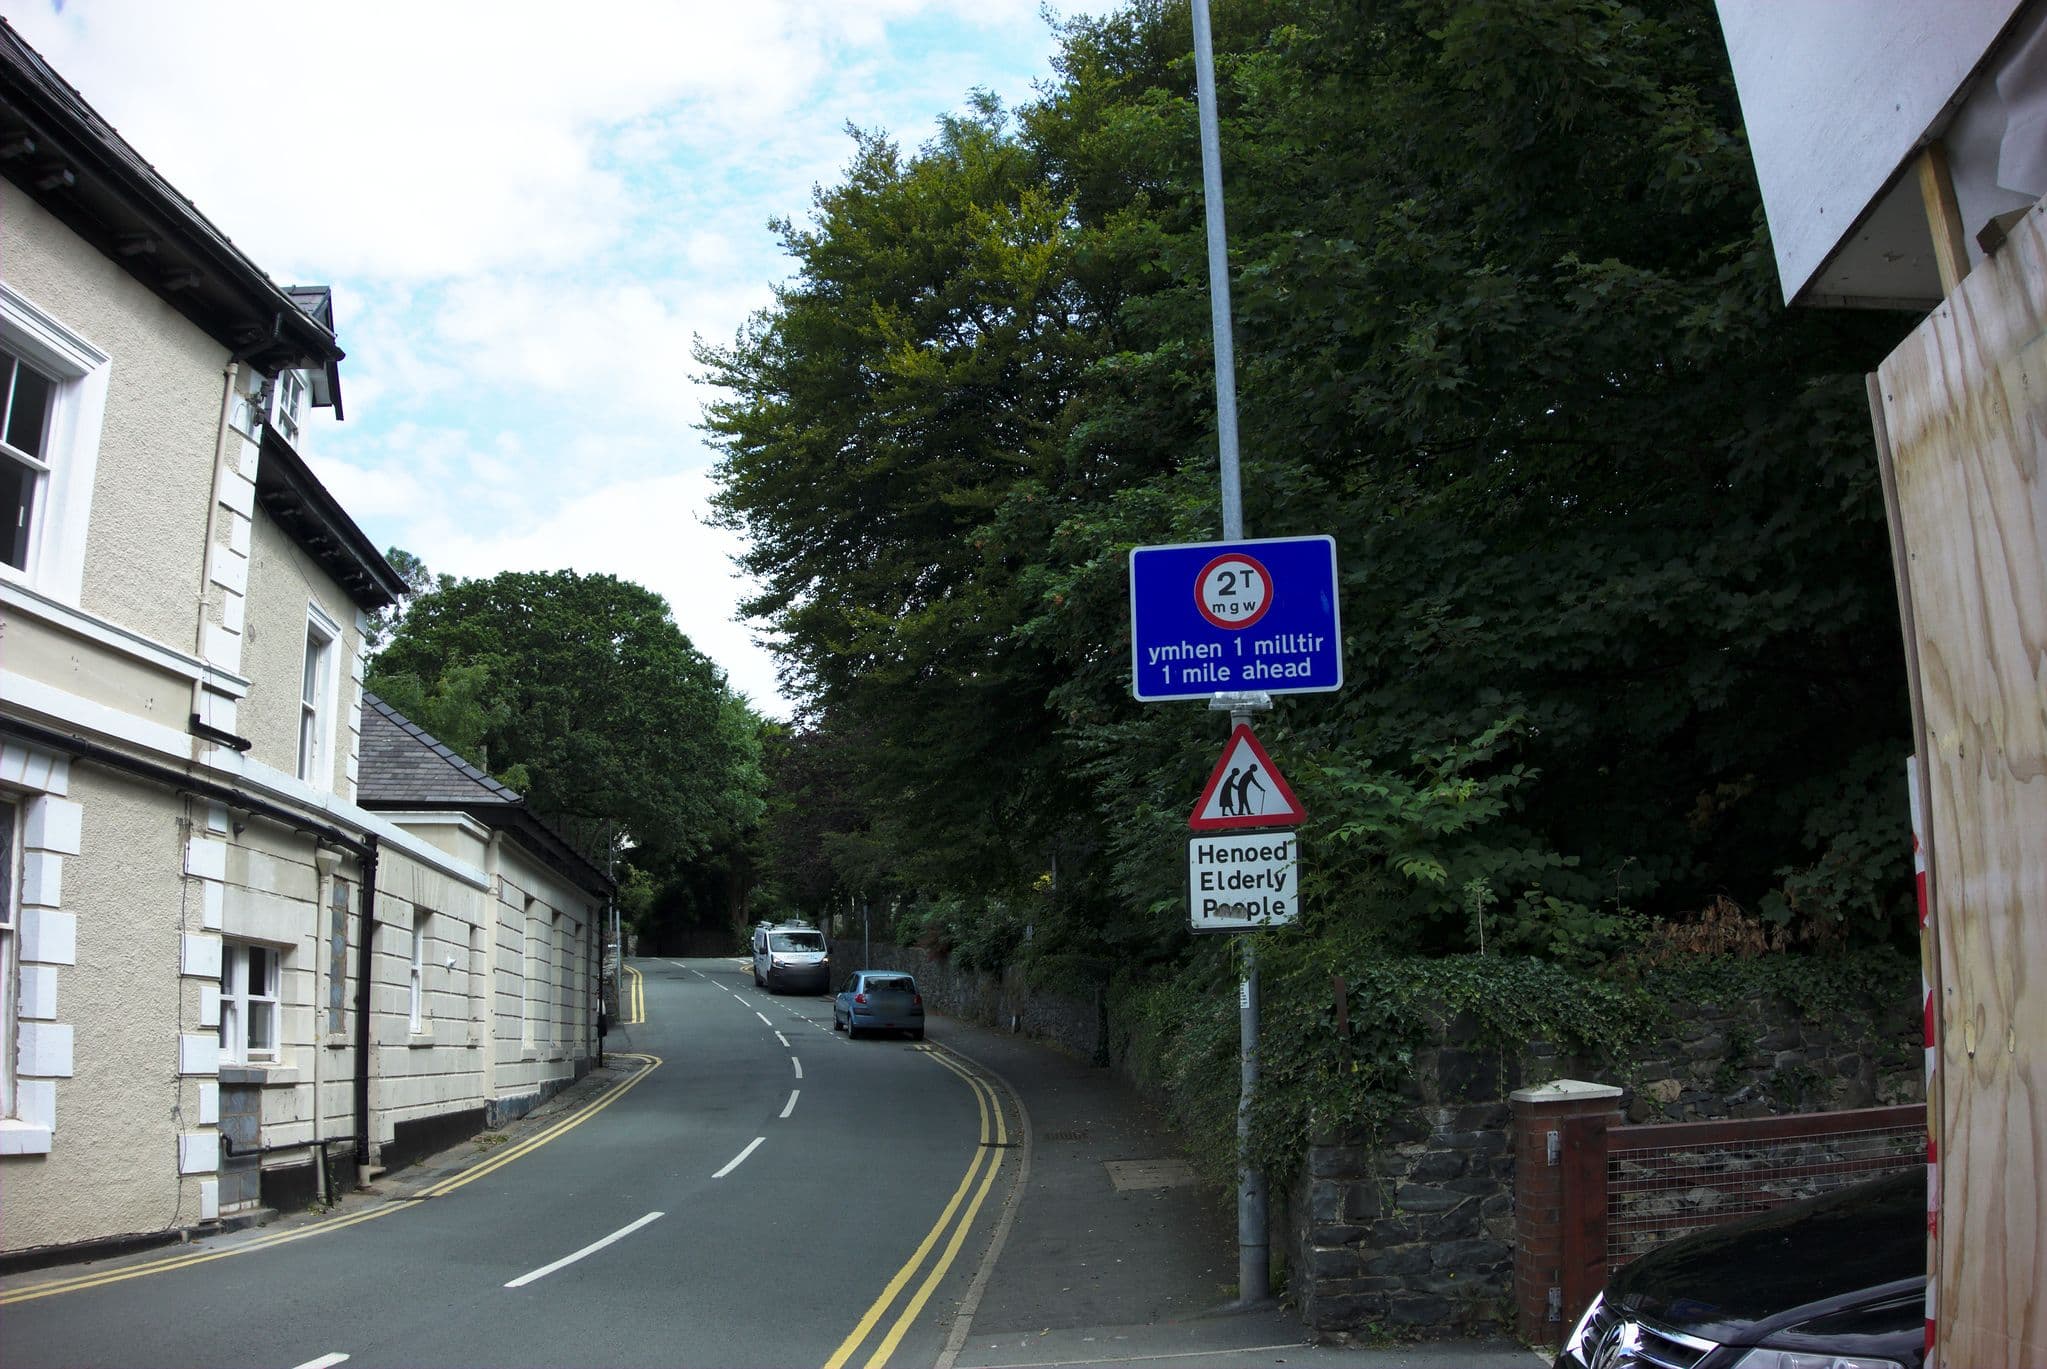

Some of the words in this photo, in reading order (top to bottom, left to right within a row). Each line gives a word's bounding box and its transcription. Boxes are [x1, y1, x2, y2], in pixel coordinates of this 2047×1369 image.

[1149, 641, 1222, 665] ymhen
[1234, 637, 1242, 656] 1
[1255, 633, 1324, 655] milltir
[1162, 665, 1170, 685] 1
[1182, 663, 1231, 683] mile
[1242, 657, 1311, 680] ahead
[1198, 841, 1287, 864] Henoed
[1200, 869, 1287, 892] Elderly
